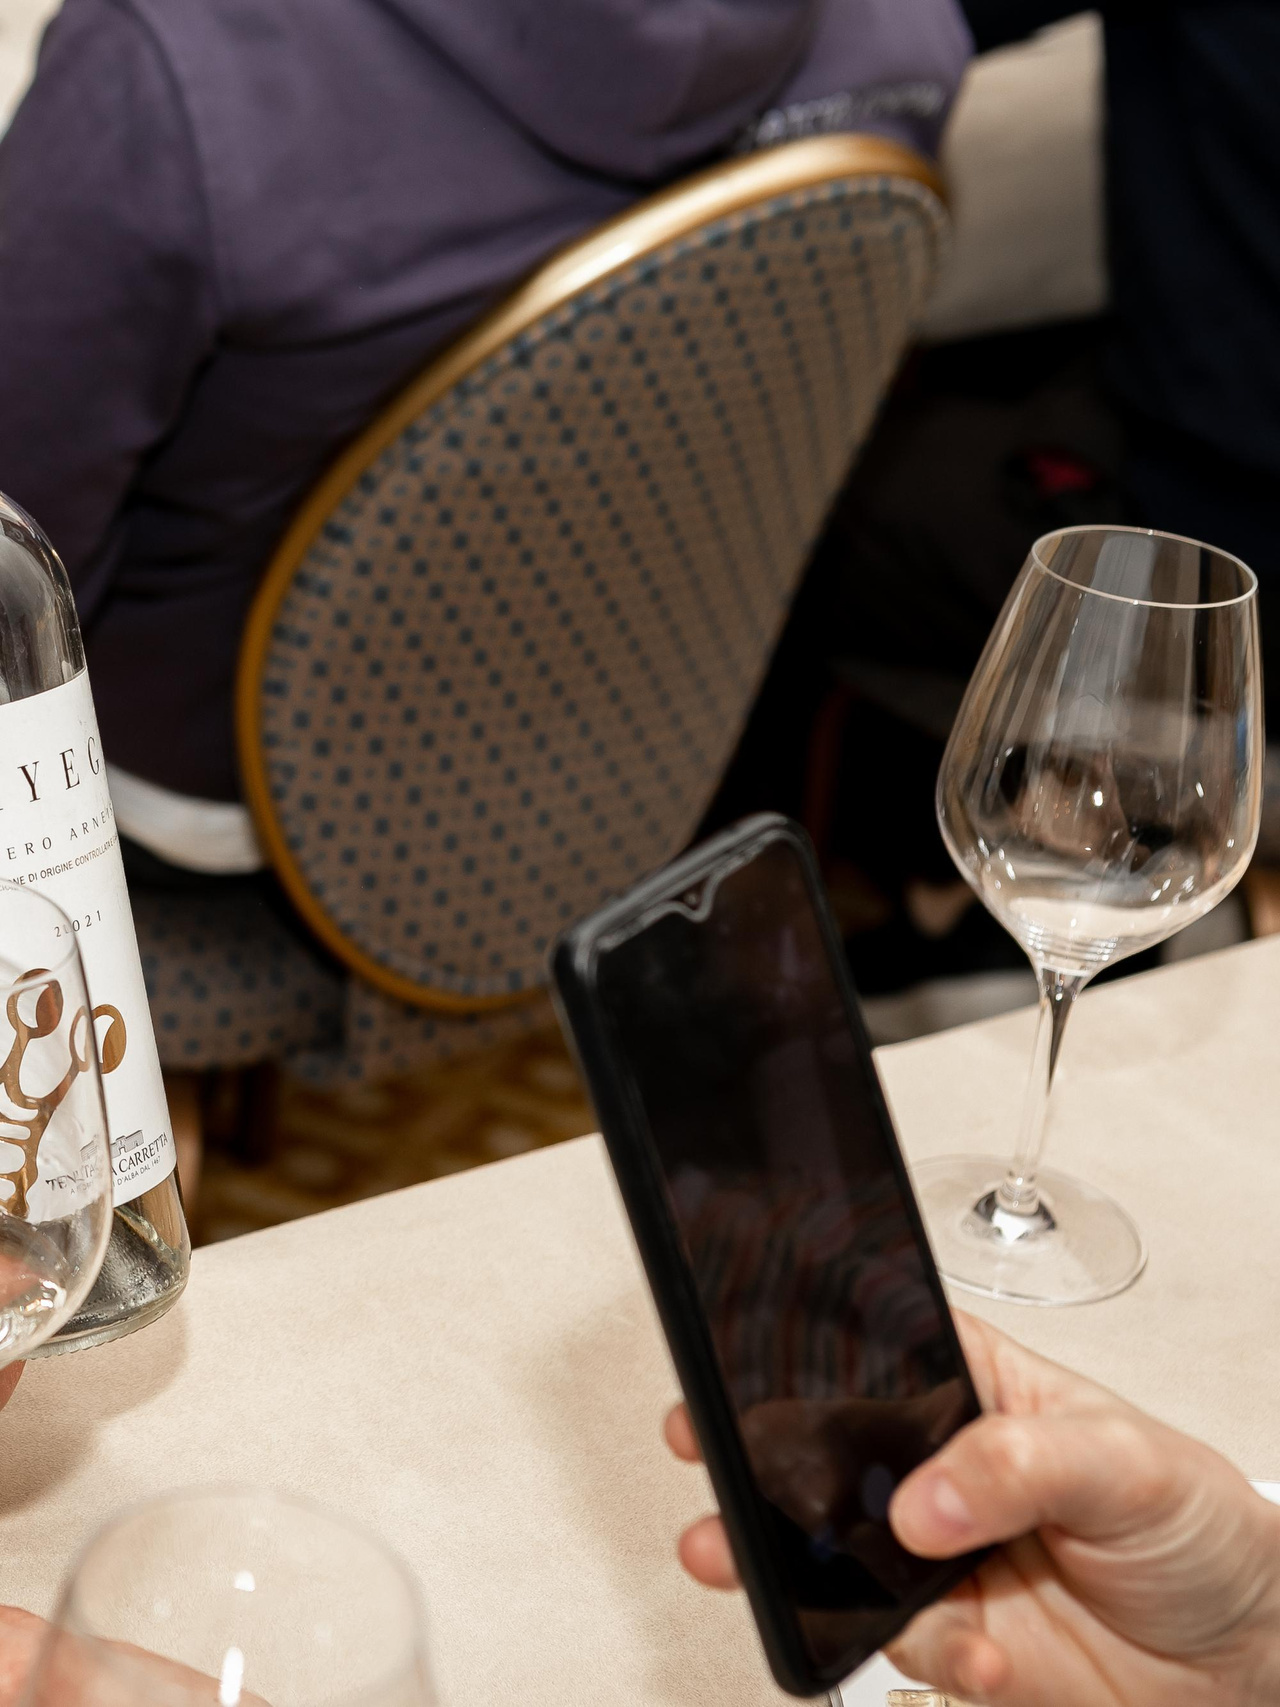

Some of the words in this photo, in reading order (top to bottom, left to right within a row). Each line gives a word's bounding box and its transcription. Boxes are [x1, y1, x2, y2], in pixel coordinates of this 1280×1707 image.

[28, 873, 38, 883] DI
[40, 860, 74, 879] ORIGINE
[118, 1131, 169, 1174] CARRETTA
[117, 1171, 139, 1186] D'ALBA
[140, 1164, 150, 1175] DAL
